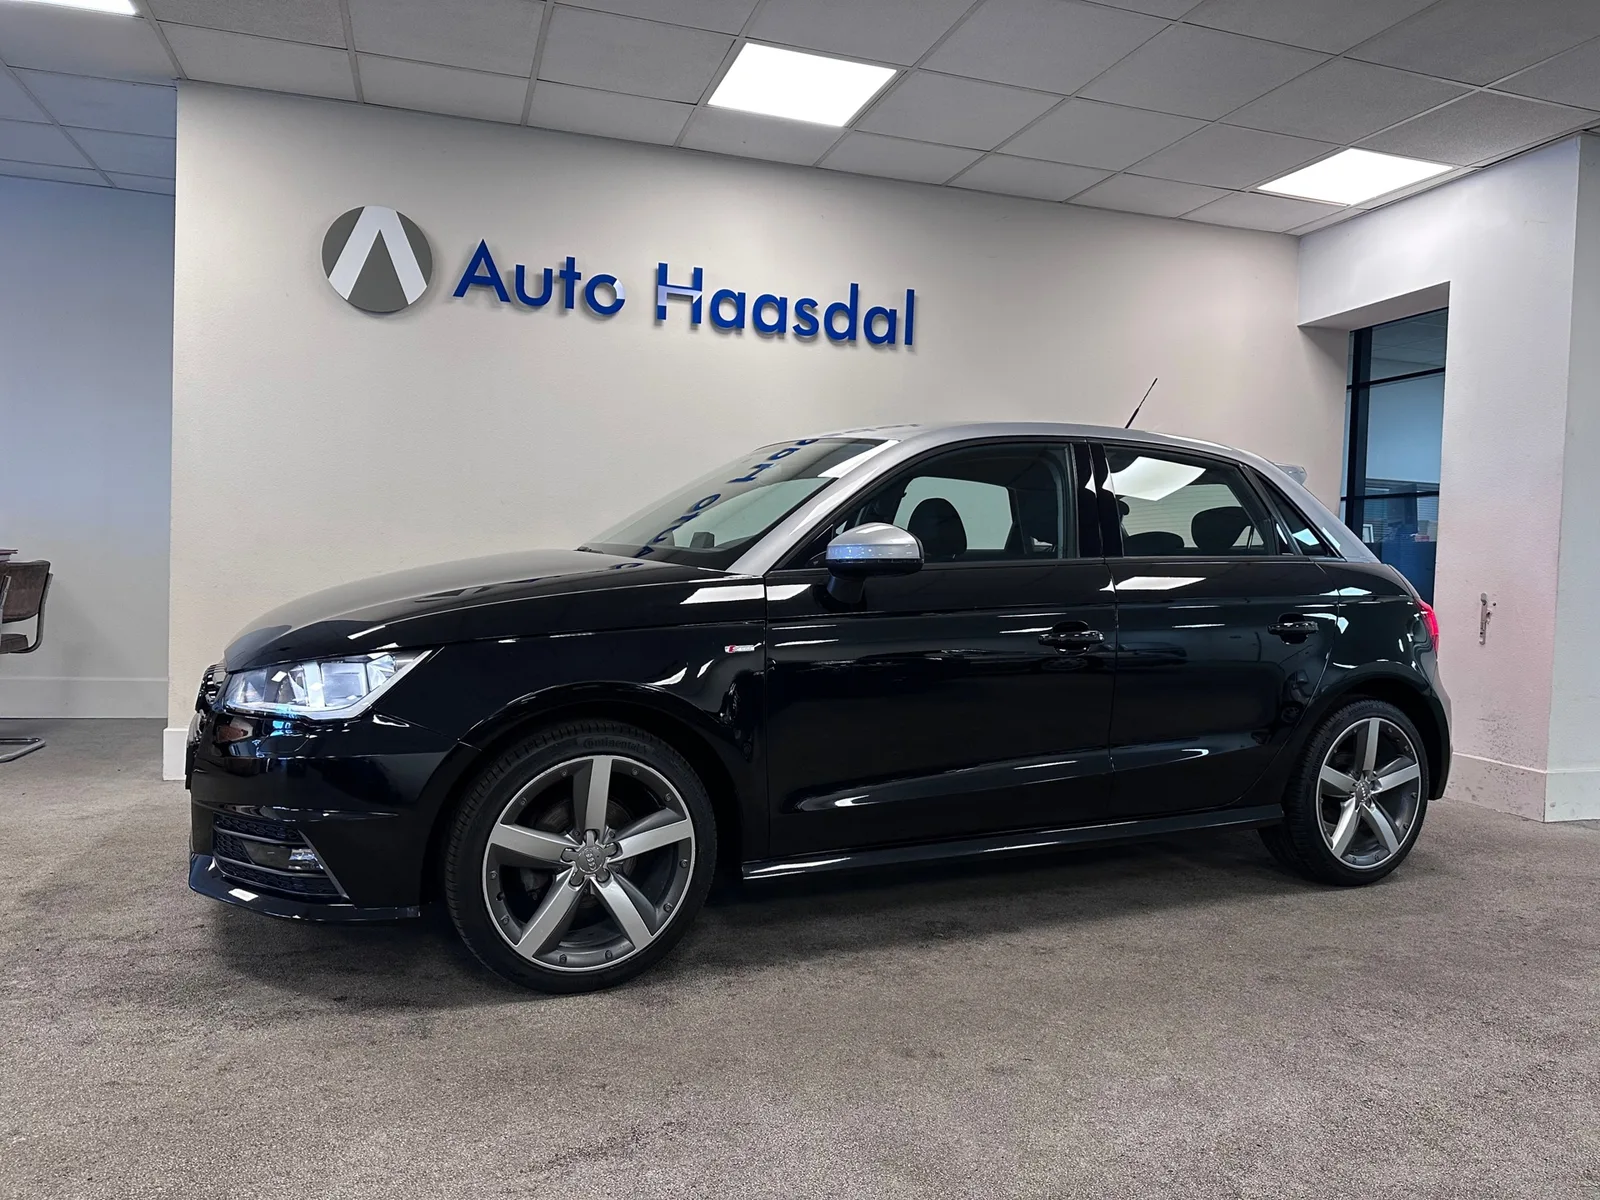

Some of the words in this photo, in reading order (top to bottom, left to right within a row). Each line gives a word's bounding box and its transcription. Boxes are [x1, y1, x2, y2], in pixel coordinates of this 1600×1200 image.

[452, 239, 626, 317] Auto
[657, 262, 916, 347] Haasdal
[583, 737, 640, 753] Continental
